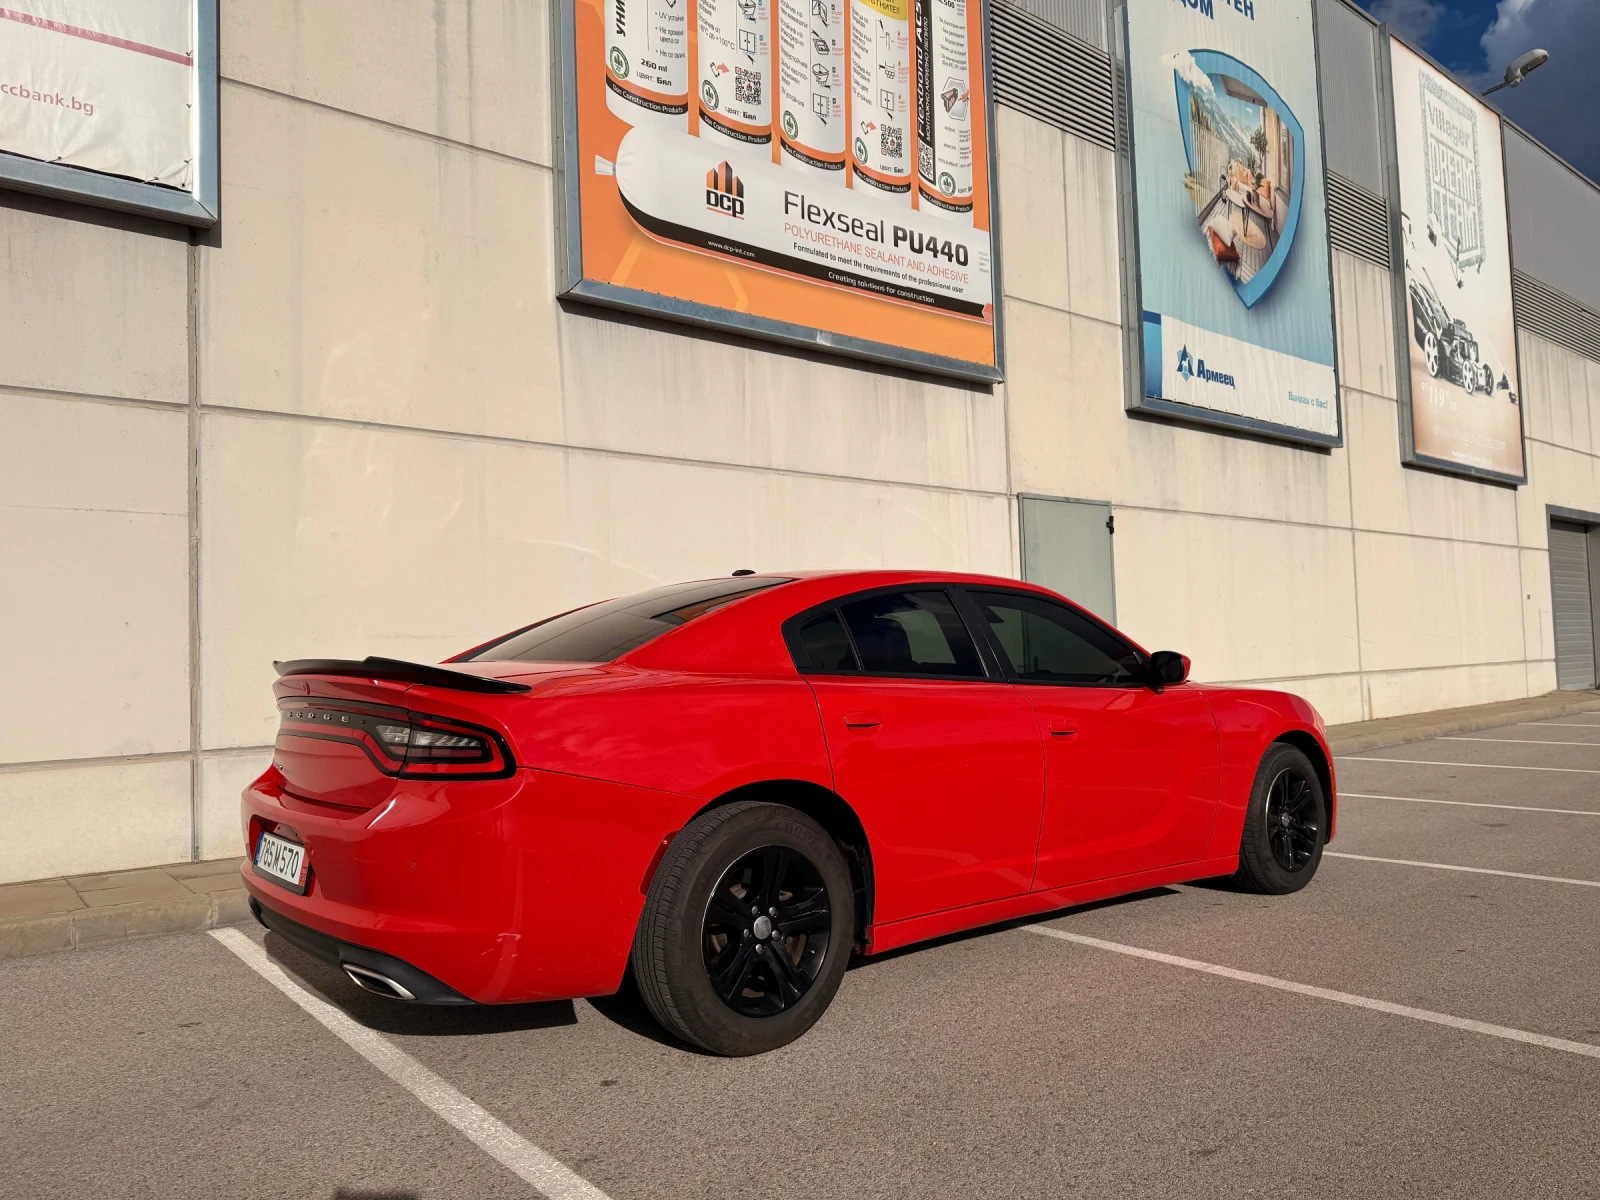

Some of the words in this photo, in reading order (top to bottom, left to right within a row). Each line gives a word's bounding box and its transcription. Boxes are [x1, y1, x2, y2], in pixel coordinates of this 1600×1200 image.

[640, 58, 657, 70] 260
[0, 83, 94, 116] ccbank.bg
[622, 91, 661, 110] Construction
[662, 105, 684, 114] Products
[712, 121, 747, 140] Construction
[747, 135, 767, 143] Products
[792, 150, 824, 167] Construction
[824, 162, 842, 170] Products
[1430, 140, 1476, 207] DREAM
[863, 174, 891, 190] Construction
[928, 194, 955, 210] Construction
[784, 190, 885, 244] Flexseal
[893, 225, 969, 267] PU440
[707, 240, 756, 258] www.dcp-int.com
[784, 222, 862, 256] POLYURETHANE
[864, 246, 905, 267] SEALANT
[907, 258, 926, 273] AND
[926, 264, 969, 284] ADHESIVE
[793, 242, 829, 259] Formulated
[829, 253, 837, 262] to
[837, 256, 852, 266] meet
[853, 260, 862, 269] the
[863, 262, 901, 279] requirements
[908, 274, 917, 283] the
[918, 277, 951, 291] professional
[951, 285, 964, 293] user
[828, 271, 856, 286] Creating
[857, 280, 886, 292] solutions
[886, 286, 896, 294] for
[896, 288, 935, 304] construction
[1196, 358, 1236, 390] Армеец
